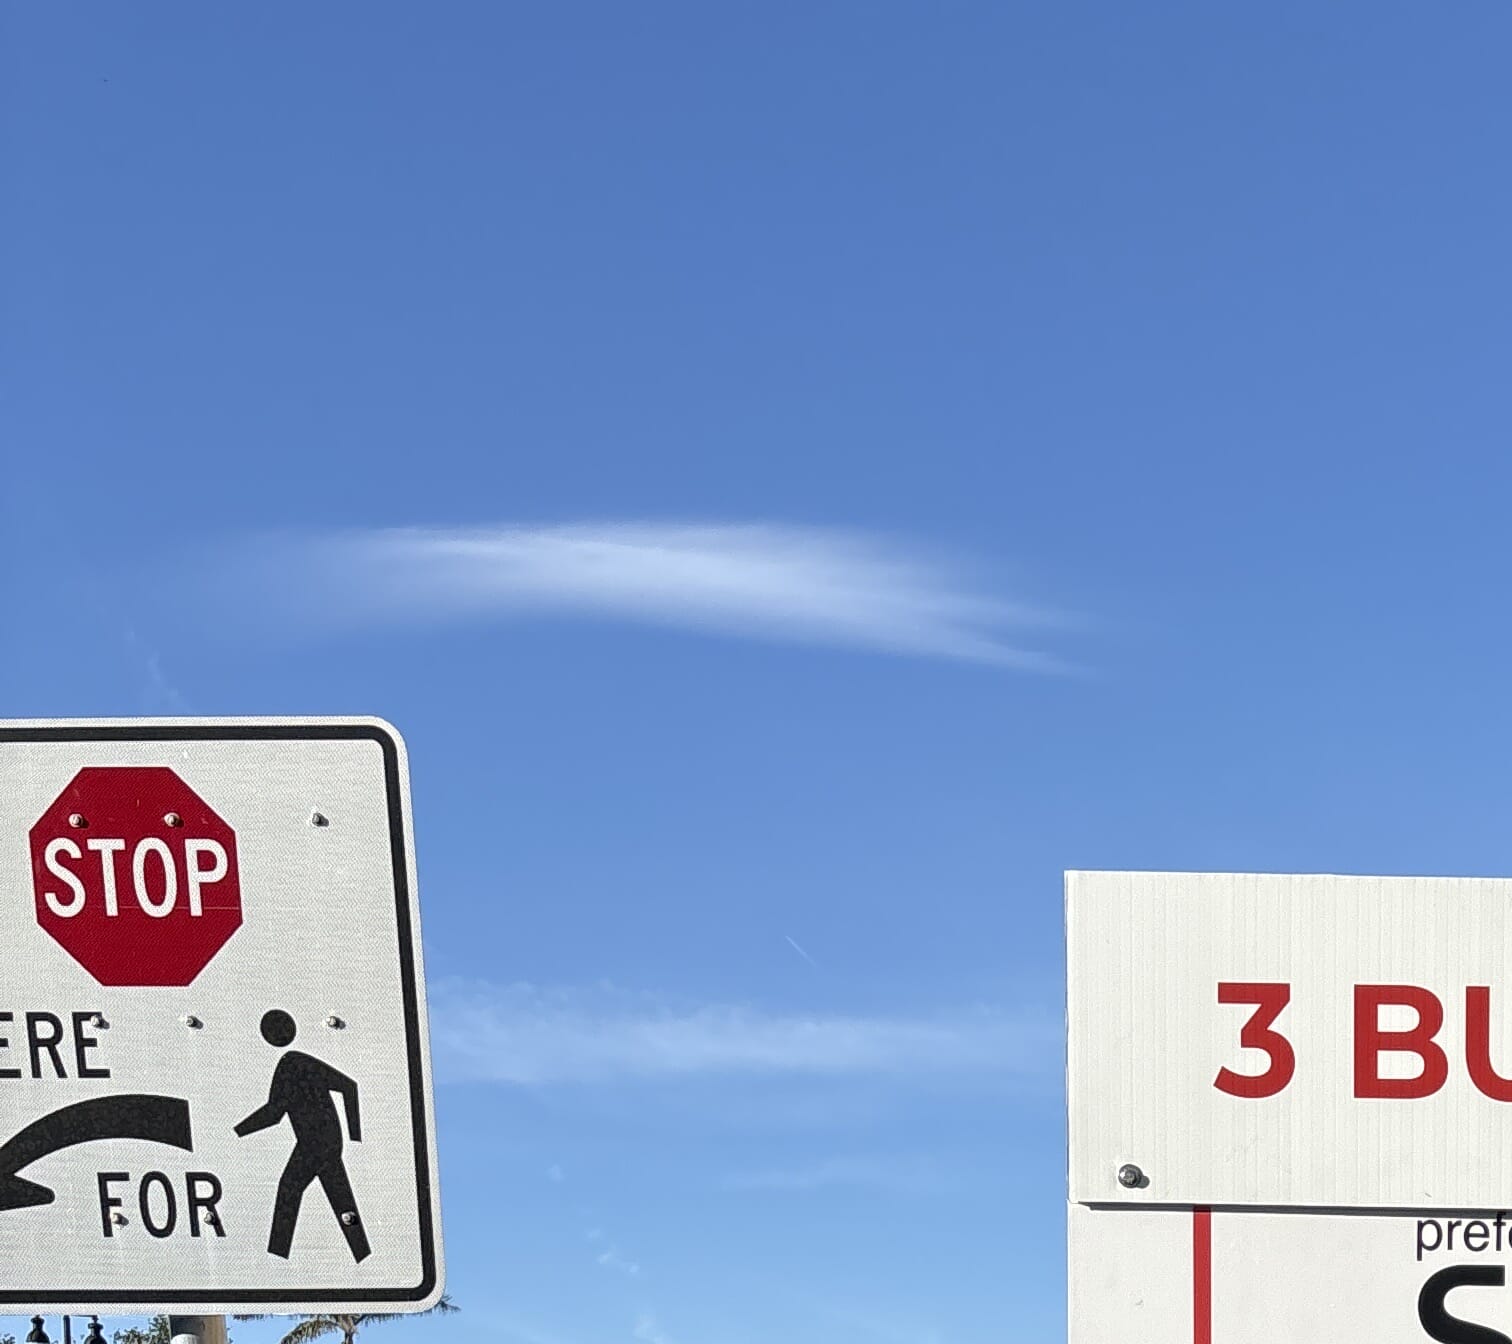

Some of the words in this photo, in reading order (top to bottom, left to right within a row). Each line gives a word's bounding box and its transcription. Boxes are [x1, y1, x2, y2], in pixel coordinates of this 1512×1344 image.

[44, 837, 228, 918] STOP
[1214, 982, 1296, 1099] 3
[97, 1171, 226, 1239] FOR
